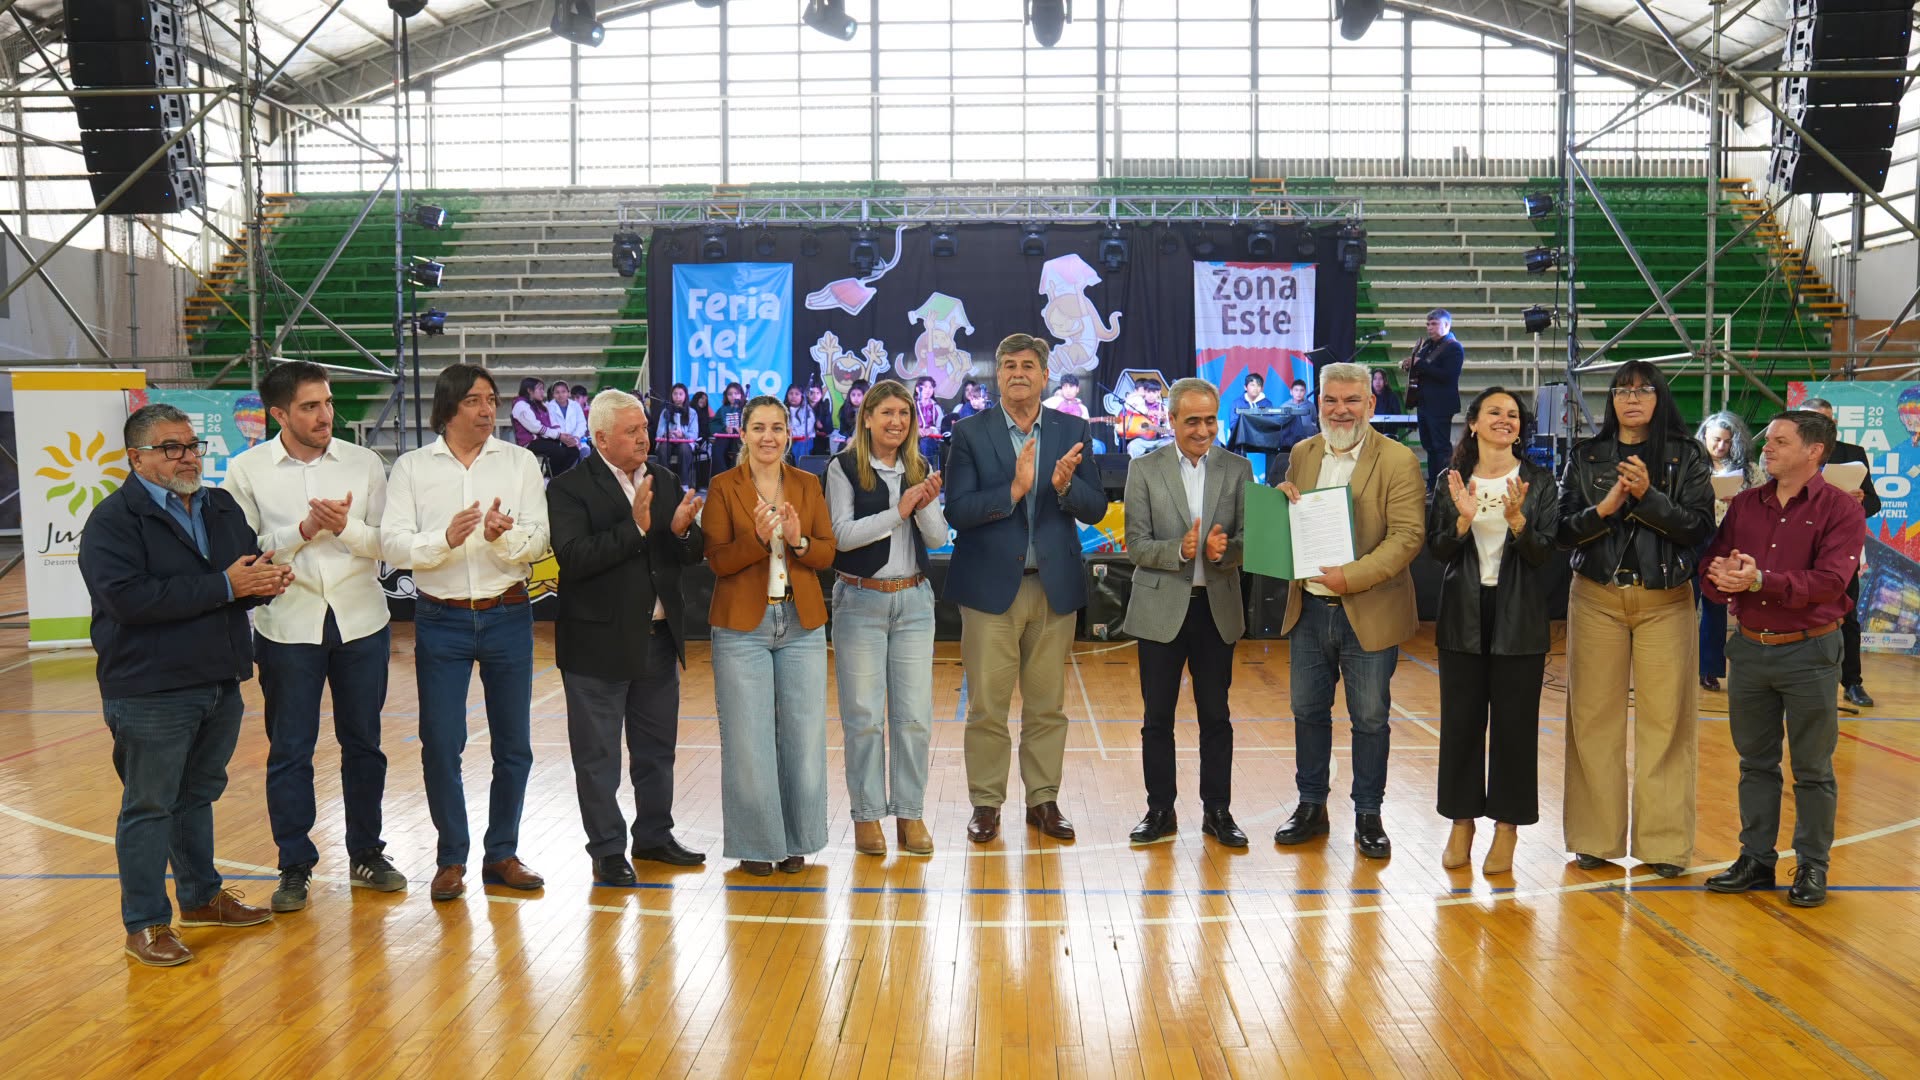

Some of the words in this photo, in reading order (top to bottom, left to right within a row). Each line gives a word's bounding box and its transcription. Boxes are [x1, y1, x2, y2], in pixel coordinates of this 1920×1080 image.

[1212, 269, 1297, 301] Zona
[688, 286, 780, 321] Feria
[1221, 304, 1292, 335] Este
[688, 324, 747, 359] del
[687, 360, 782, 396] Libro
[207, 413, 222, 423] 20
[1830, 405, 1865, 428] E
[1867, 417, 1883, 427] 26
[1868, 406, 1884, 416] 20
[207, 423, 222, 433] 26
[1835, 429, 1891, 451] IA
[37, 521, 84, 554] Ju
